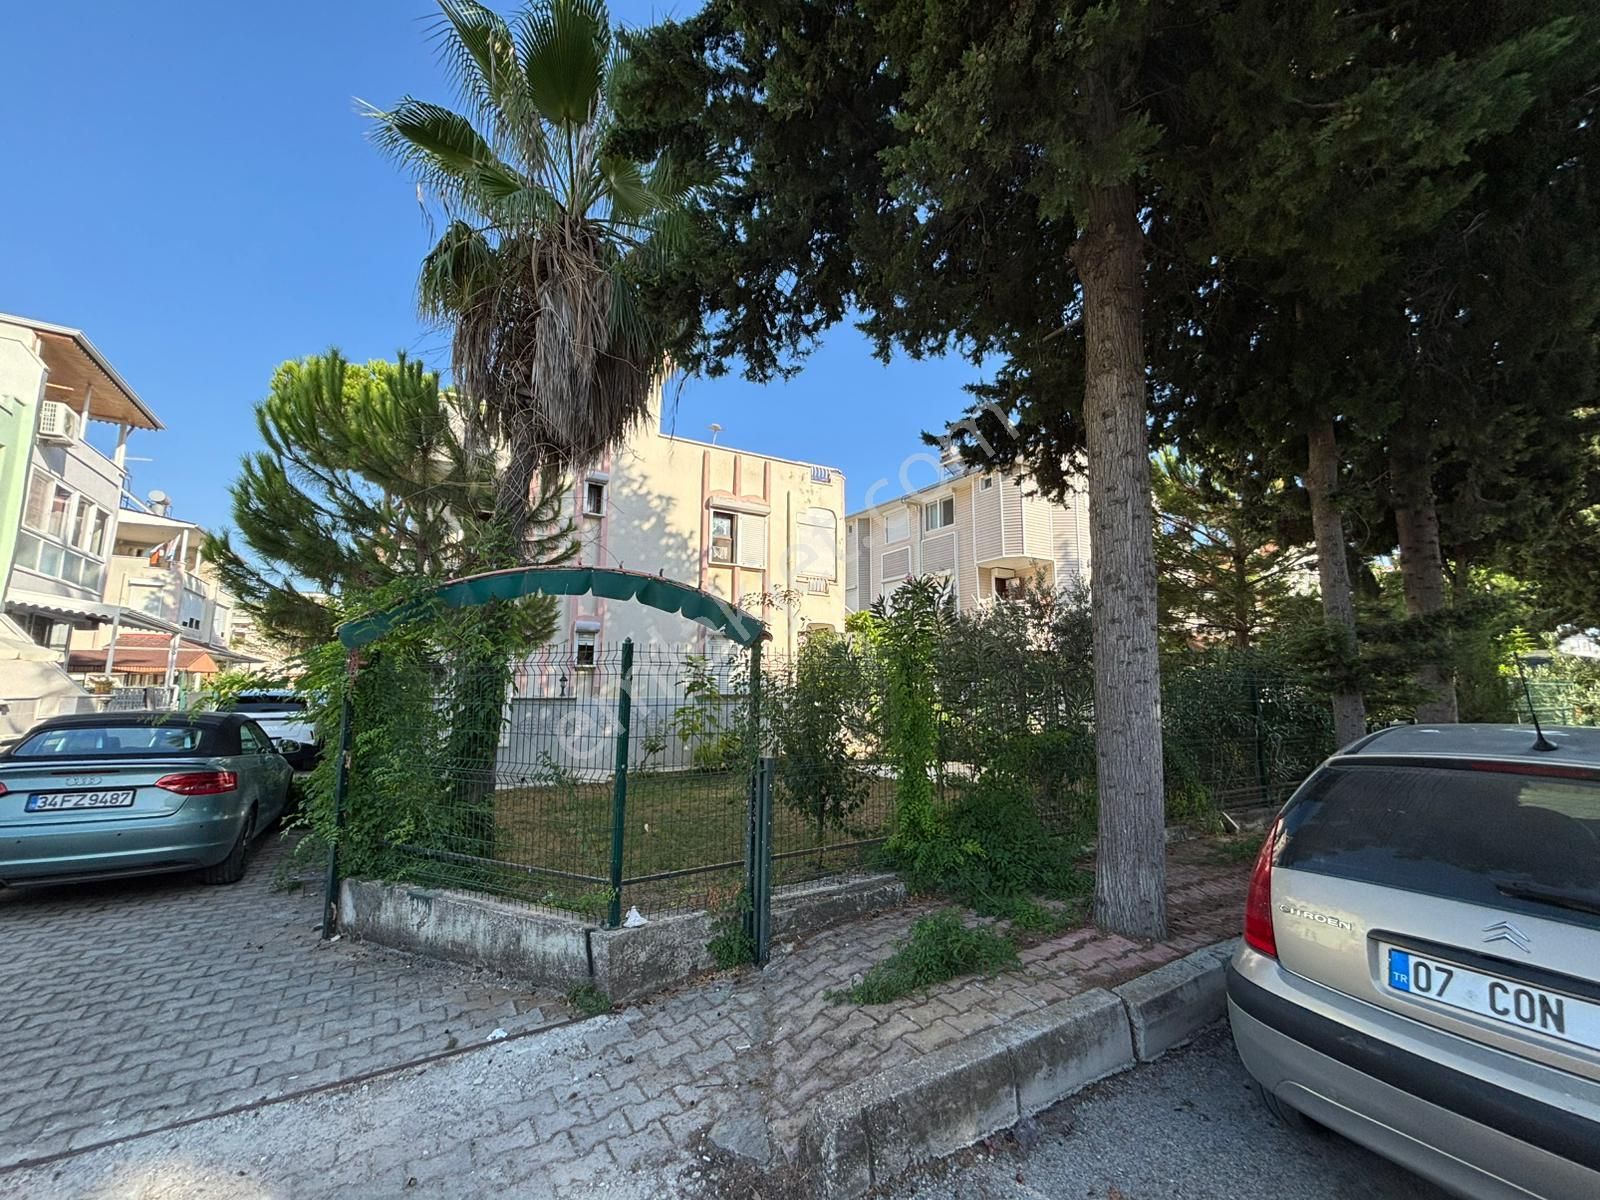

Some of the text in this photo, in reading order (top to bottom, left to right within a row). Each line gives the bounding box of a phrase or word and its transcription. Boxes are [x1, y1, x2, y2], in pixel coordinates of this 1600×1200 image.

[1393, 971, 1408, 984] TR
[1413, 961, 1565, 1034] 07 CON
